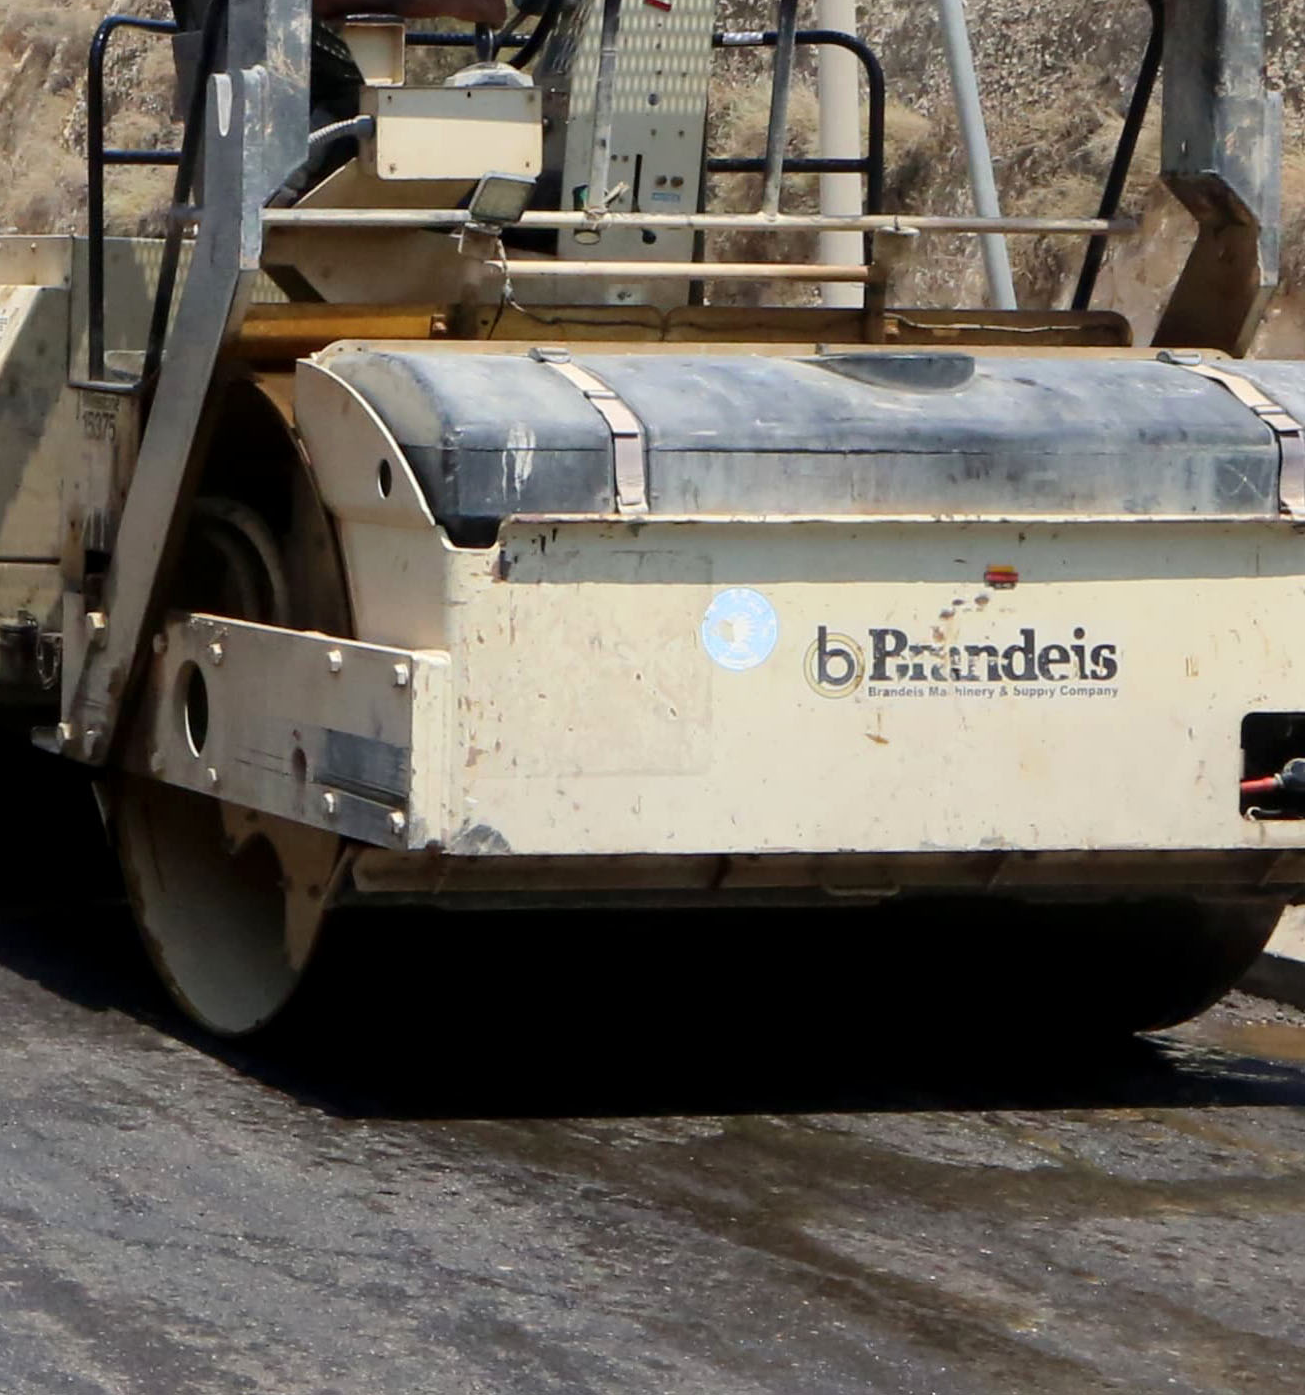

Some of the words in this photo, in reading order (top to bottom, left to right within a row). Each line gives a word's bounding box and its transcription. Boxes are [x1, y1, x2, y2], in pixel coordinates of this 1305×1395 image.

[868, 627, 1118, 682] Brandeis
[868, 686, 924, 697] Brandeis
[929, 686, 995, 699] Mahinery
[999, 686, 1009, 697] &
[1060, 685, 1119, 699] Company
